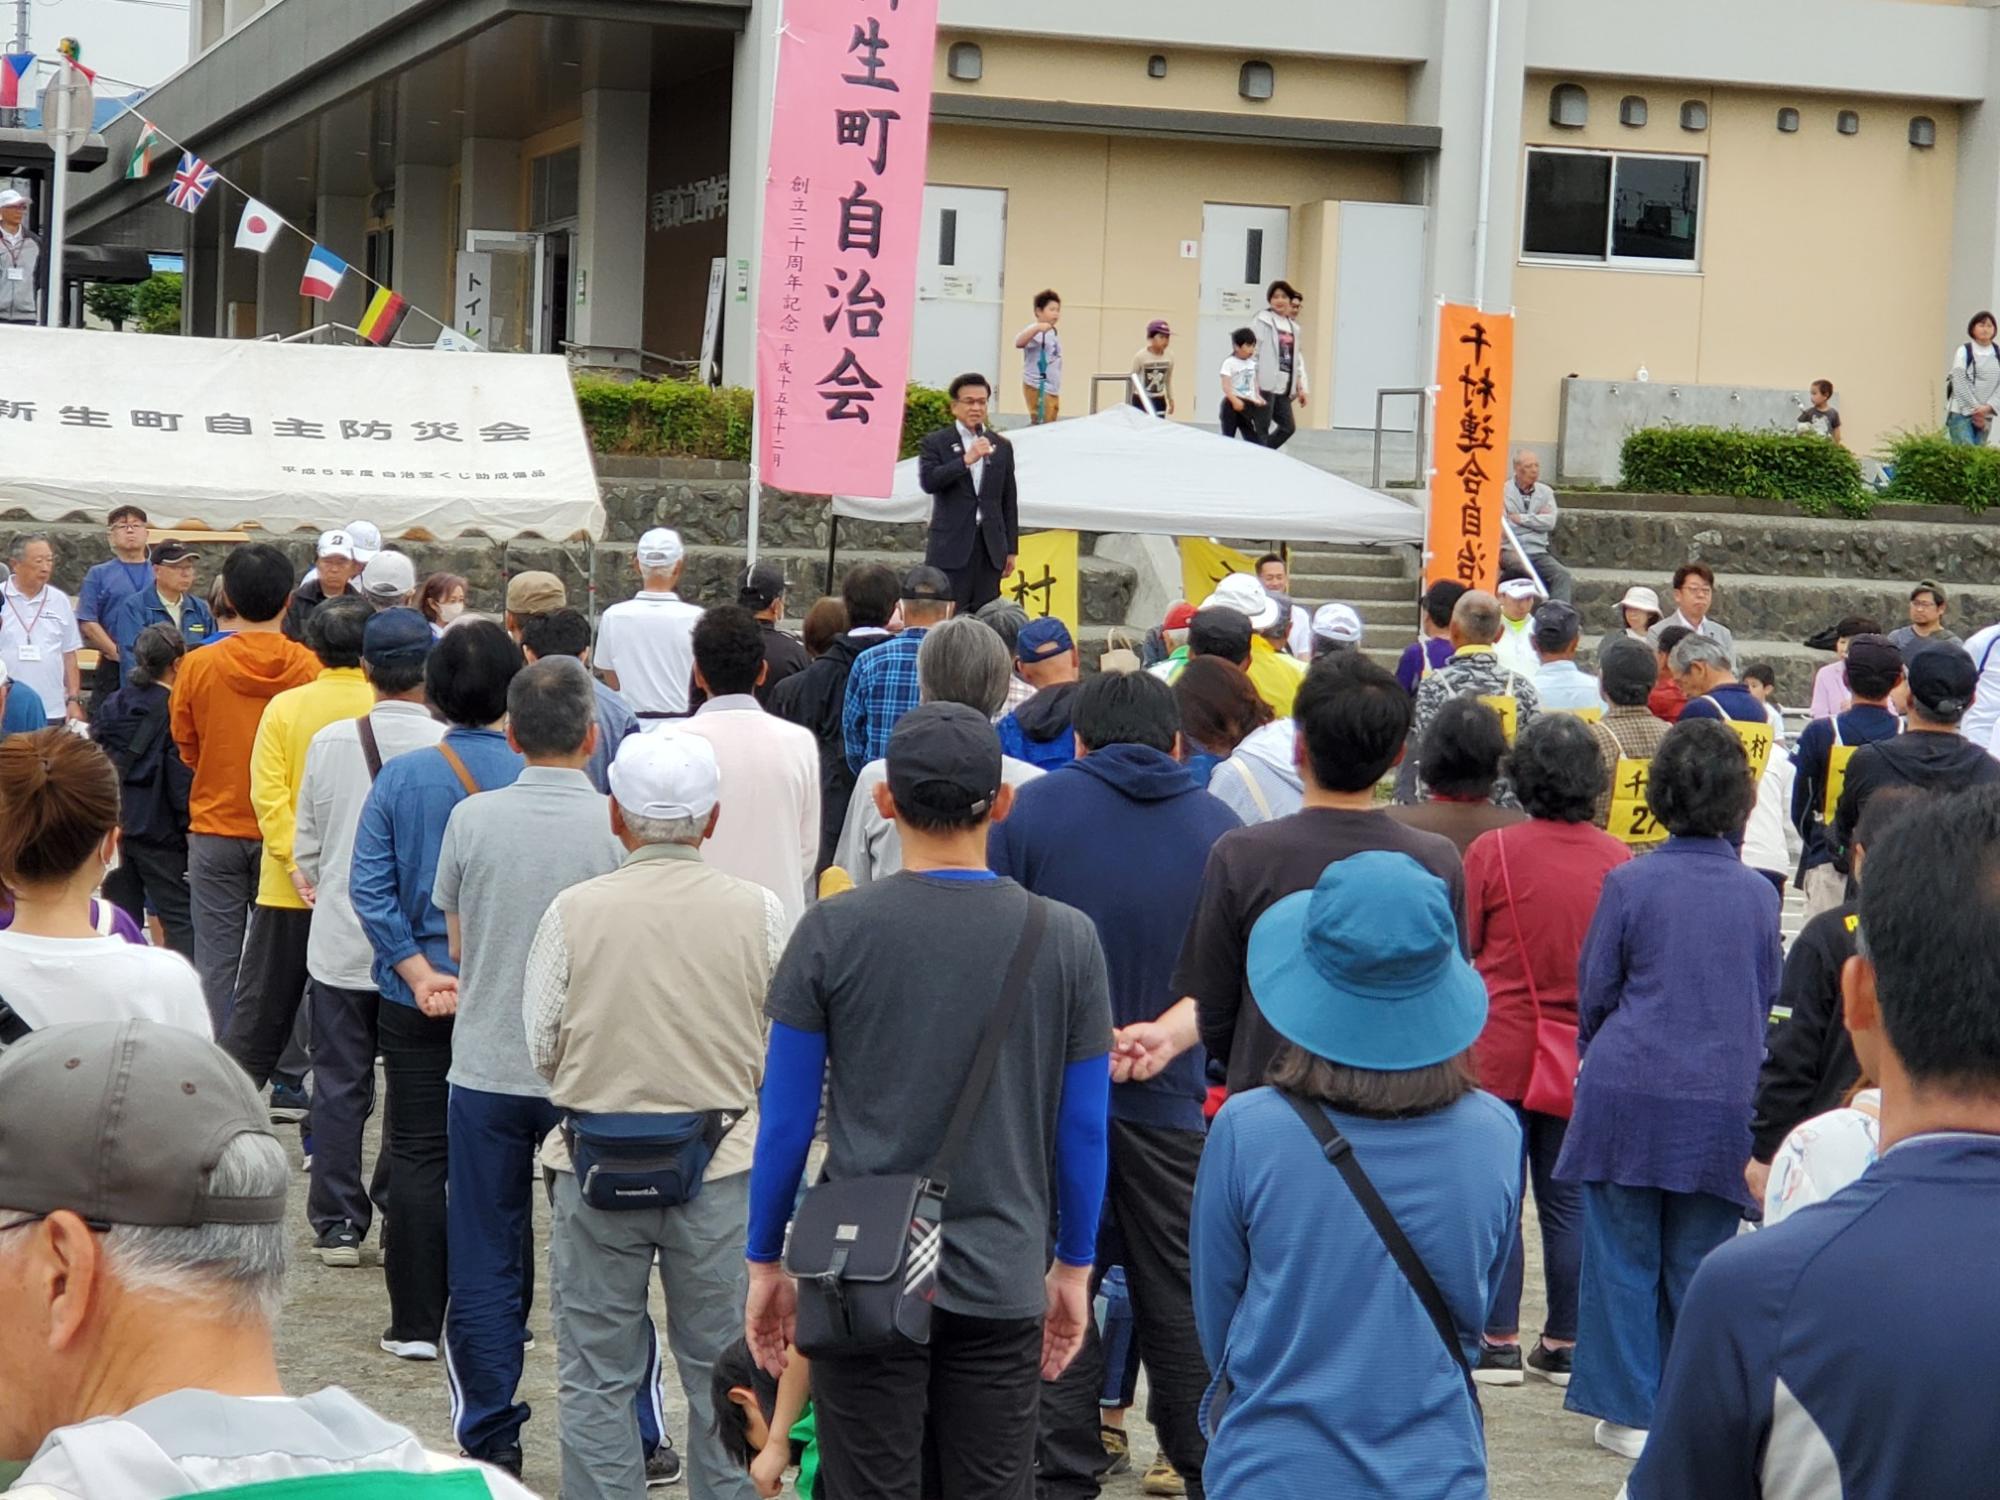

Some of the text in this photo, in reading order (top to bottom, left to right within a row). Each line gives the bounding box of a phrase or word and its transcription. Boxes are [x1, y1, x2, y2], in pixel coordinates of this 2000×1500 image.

[815, 0, 901, 425] 生町自治会
[464, 272, 482, 338] トイレ
[772, 176, 809, 467] 創立三十周年記念 平成十五年十二月
[0, 399, 531, 443] 新生町自主防災会
[1010, 563, 1057, 617] 村
